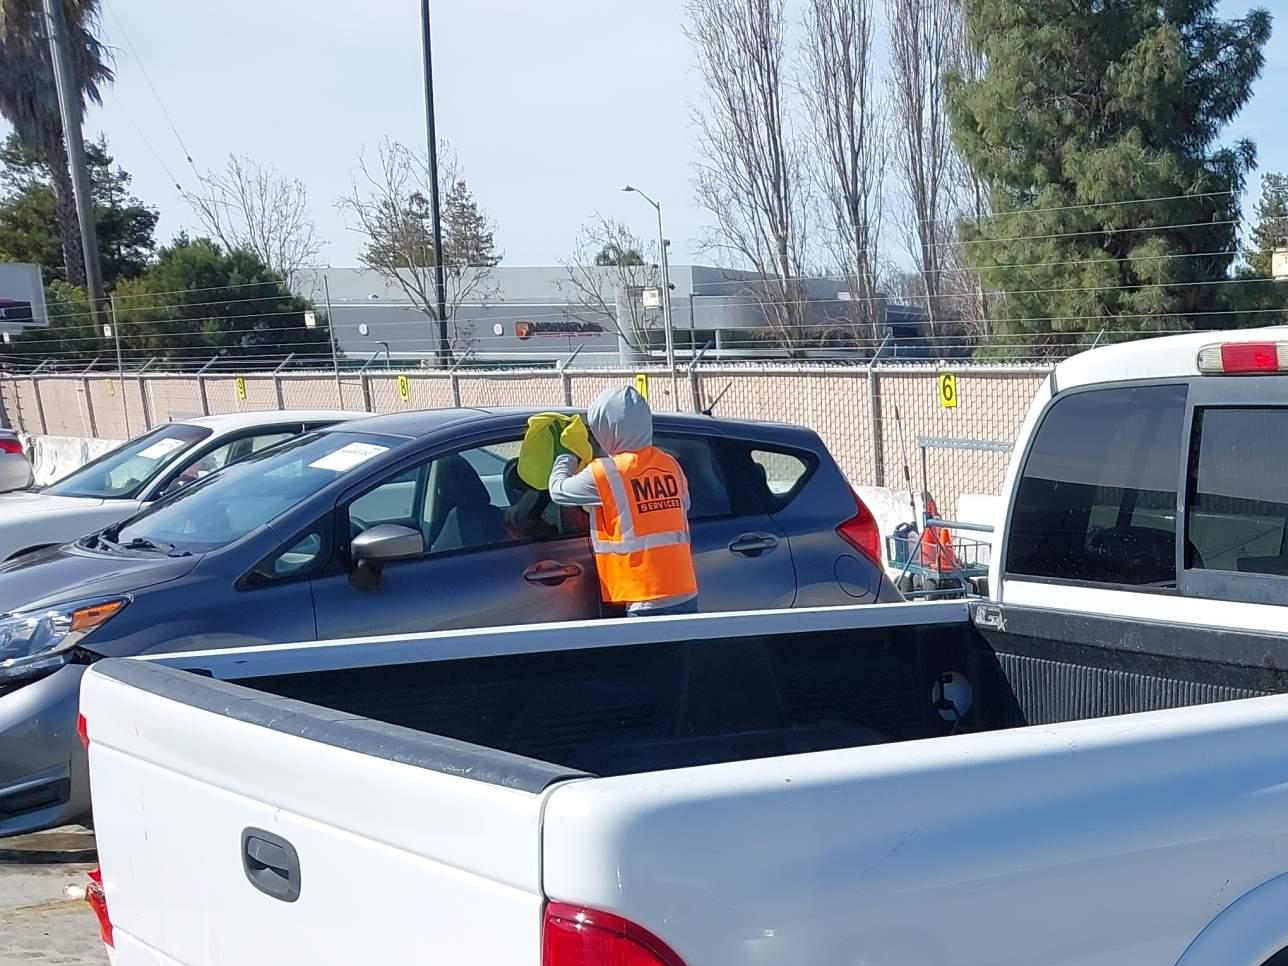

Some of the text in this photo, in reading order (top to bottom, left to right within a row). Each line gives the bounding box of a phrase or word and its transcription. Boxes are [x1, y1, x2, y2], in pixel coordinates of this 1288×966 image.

[400, 378, 407, 397] 8
[637, 377, 644, 397] 7
[942, 374, 953, 402] 6
[630, 474, 679, 502] MAD
[640, 499, 681, 512] SERVICES
